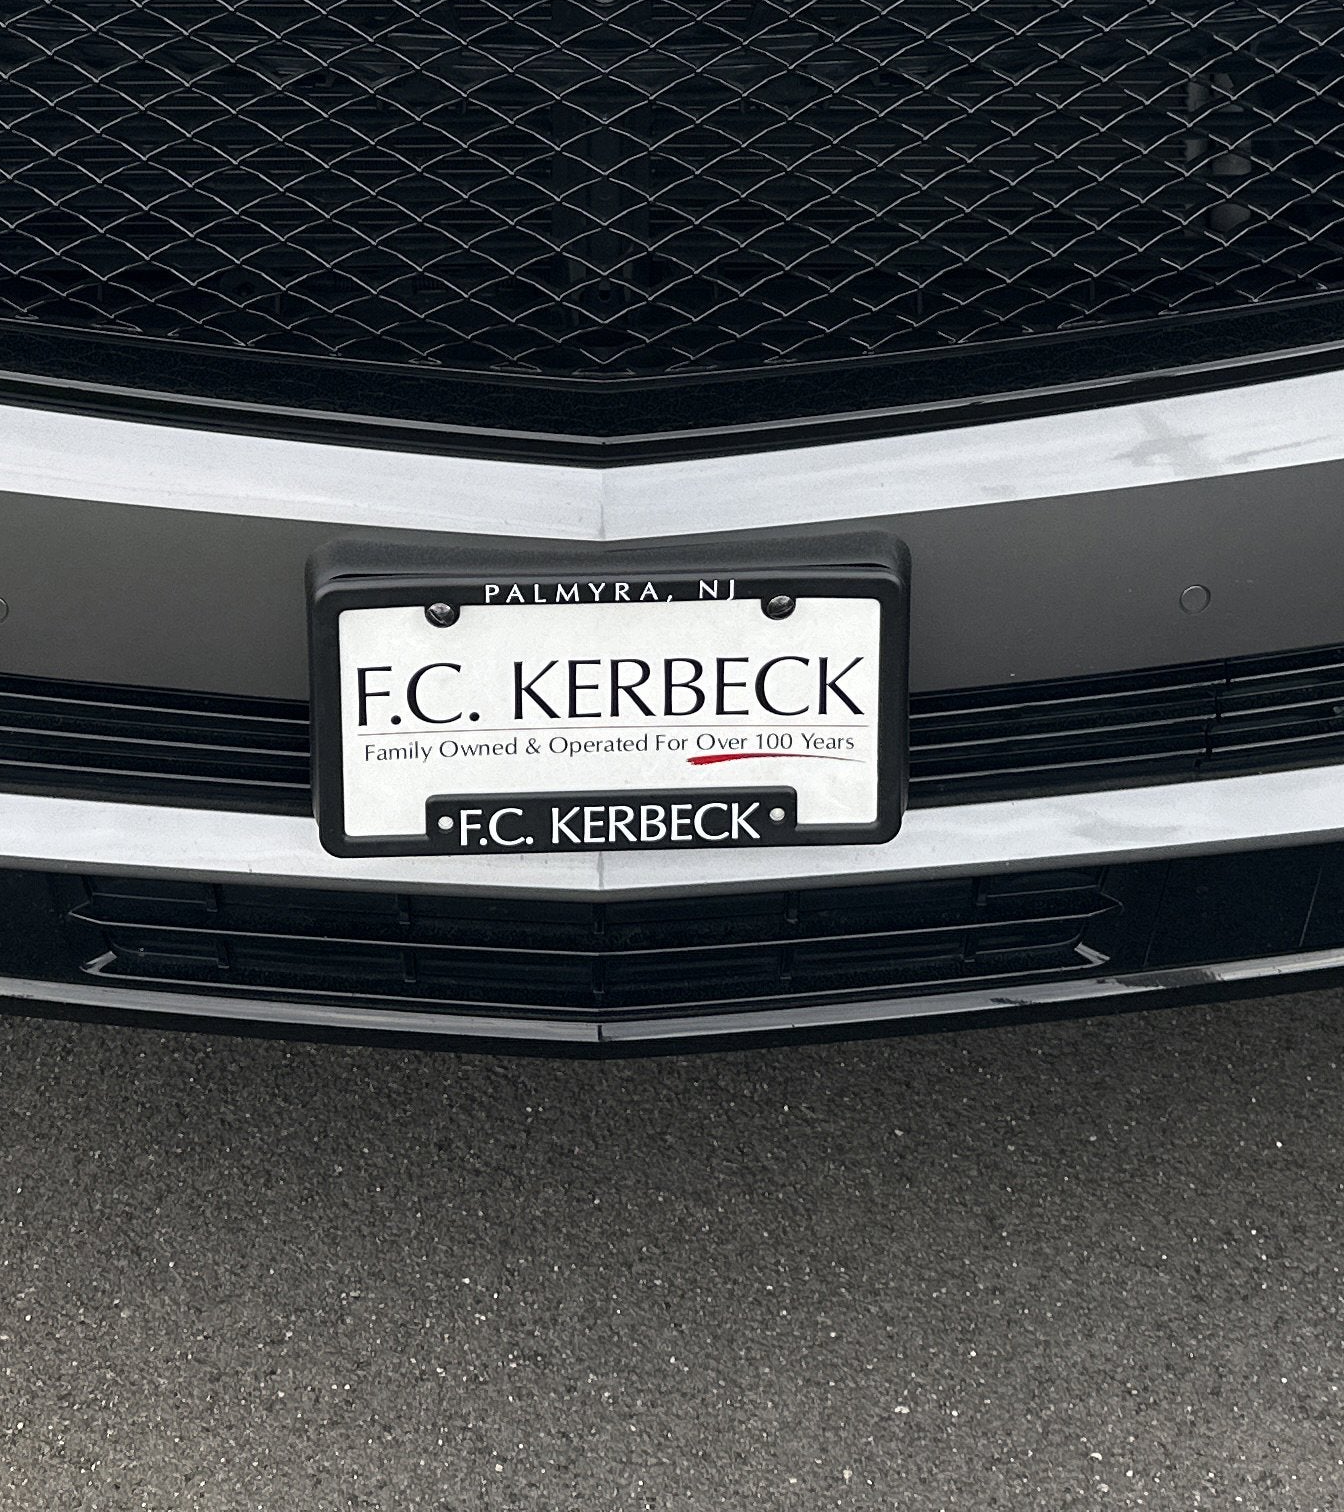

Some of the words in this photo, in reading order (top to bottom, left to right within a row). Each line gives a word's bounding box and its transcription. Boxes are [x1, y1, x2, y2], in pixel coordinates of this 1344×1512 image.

[485, 581, 674, 604] PALMYRA,
[698, 579, 735, 601] NJ
[356, 661, 481, 727] F.C.
[513, 655, 866, 721] KERBECK
[364, 740, 433, 764] Family
[439, 736, 518, 759] Owned
[525, 737, 542, 755] &
[548, 733, 649, 757] Operated
[655, 734, 689, 752] For
[696, 732, 748, 752] Over
[756, 732, 793, 751] 100
[801, 732, 855, 751] Years
[459, 806, 535, 847] F.C.
[552, 801, 762, 845] KERBECK
